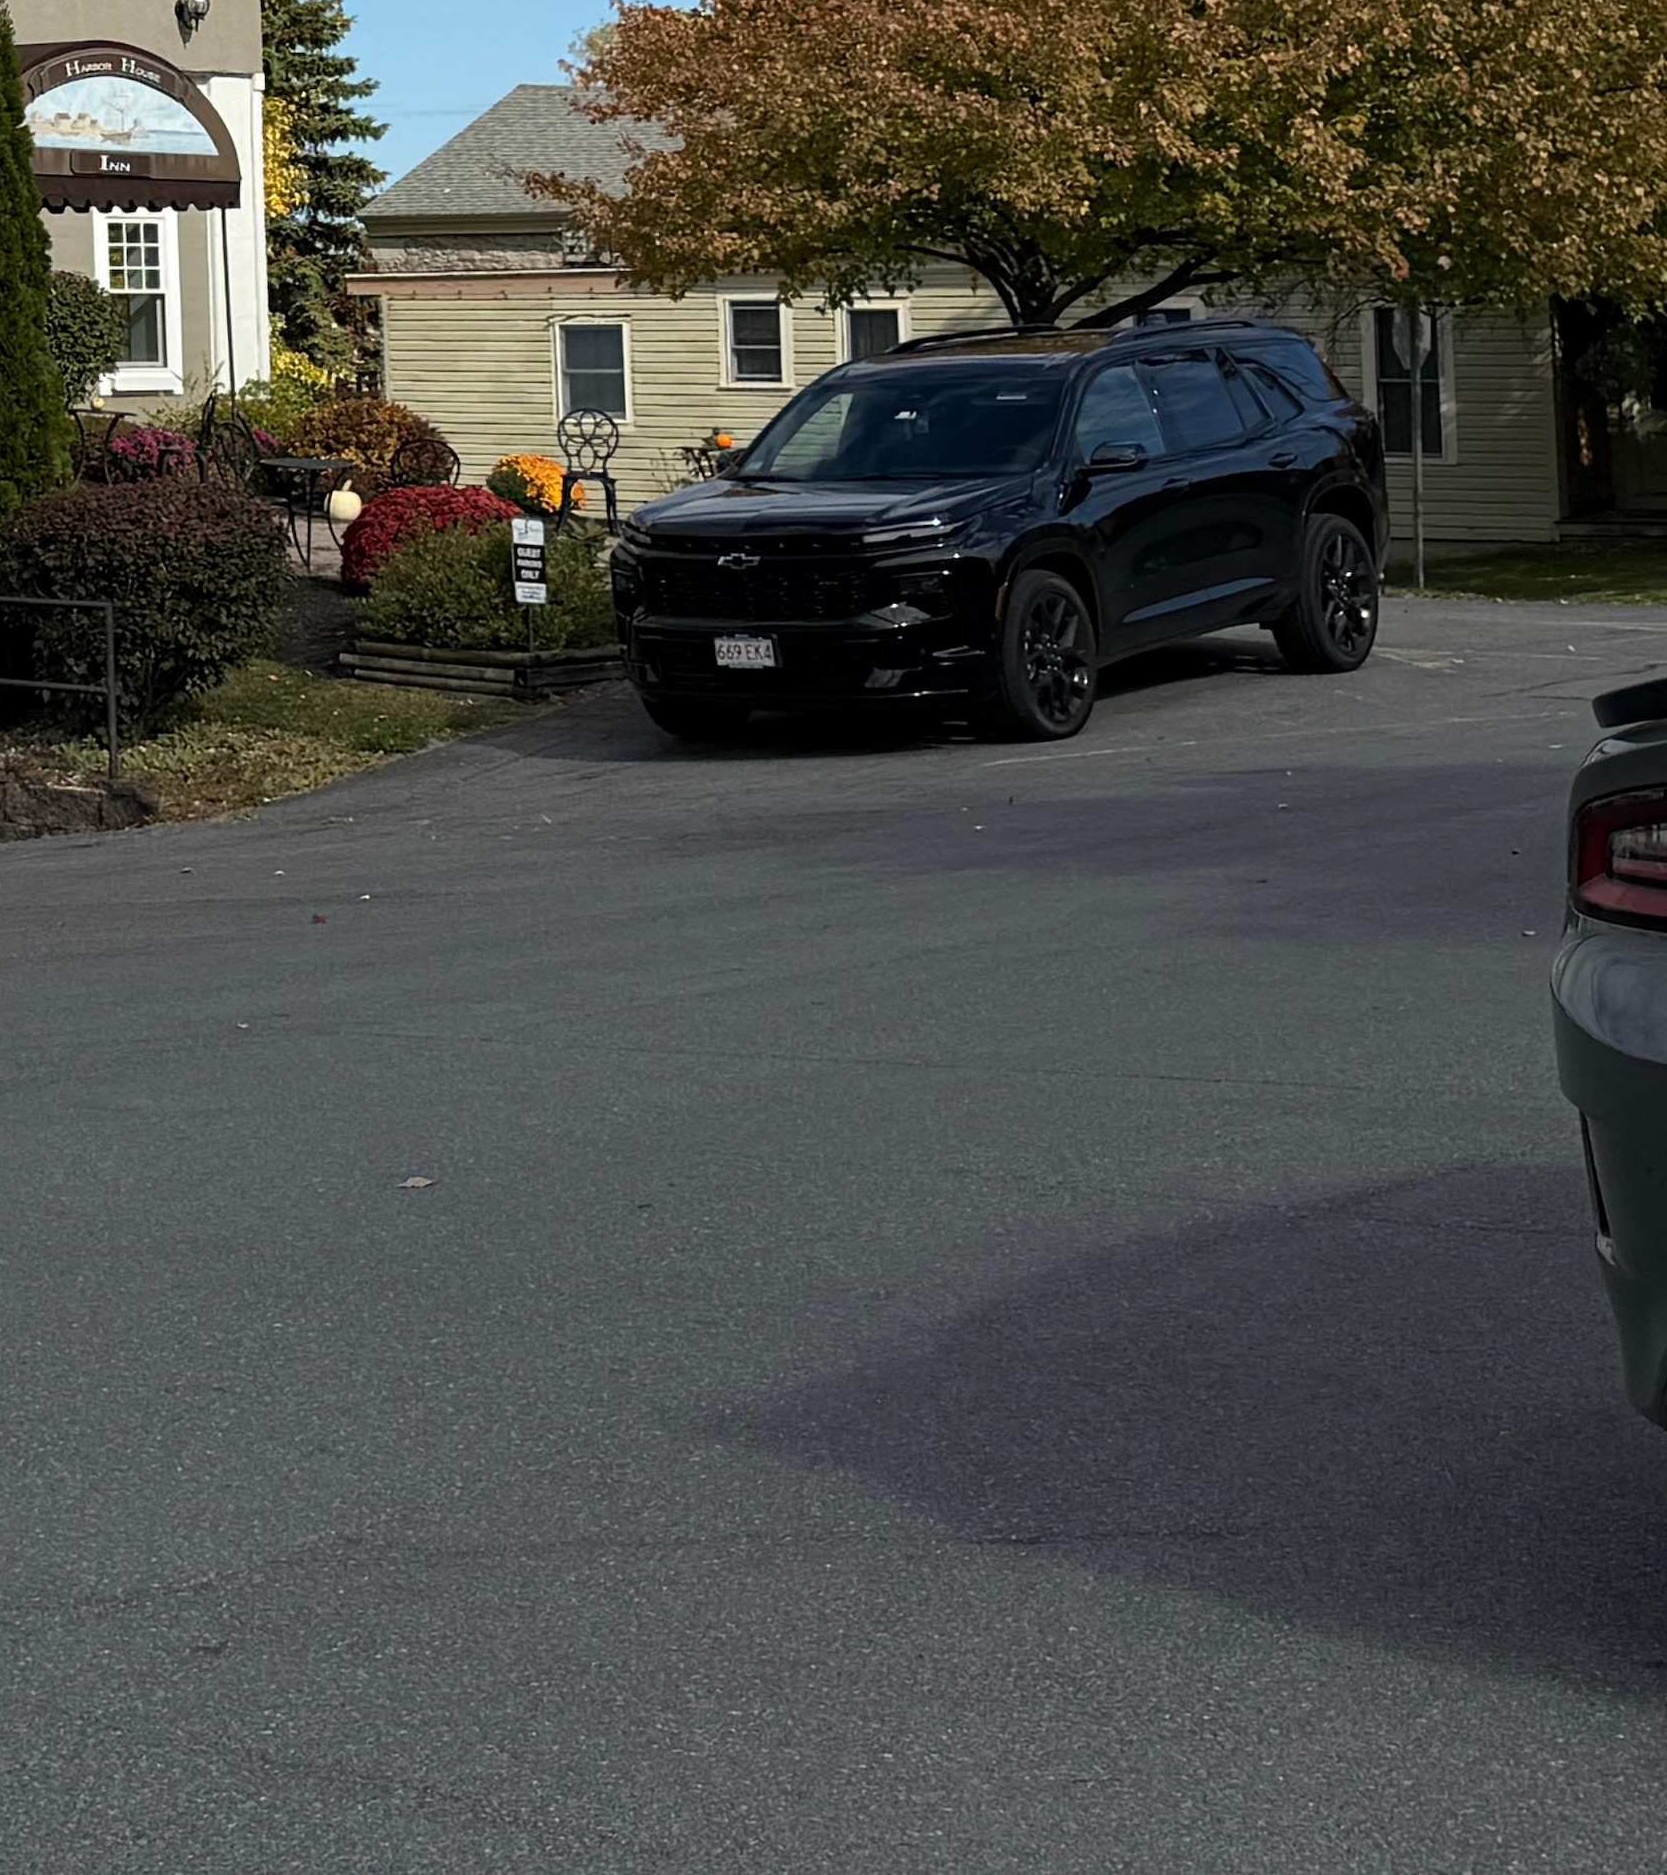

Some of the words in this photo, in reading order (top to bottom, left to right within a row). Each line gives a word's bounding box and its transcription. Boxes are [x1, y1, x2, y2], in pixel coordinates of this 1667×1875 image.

[65, 60, 113, 77] HARBOR
[121, 57, 162, 83] HOUSE
[99, 155, 131, 172] INN
[717, 643, 742, 660] 669
